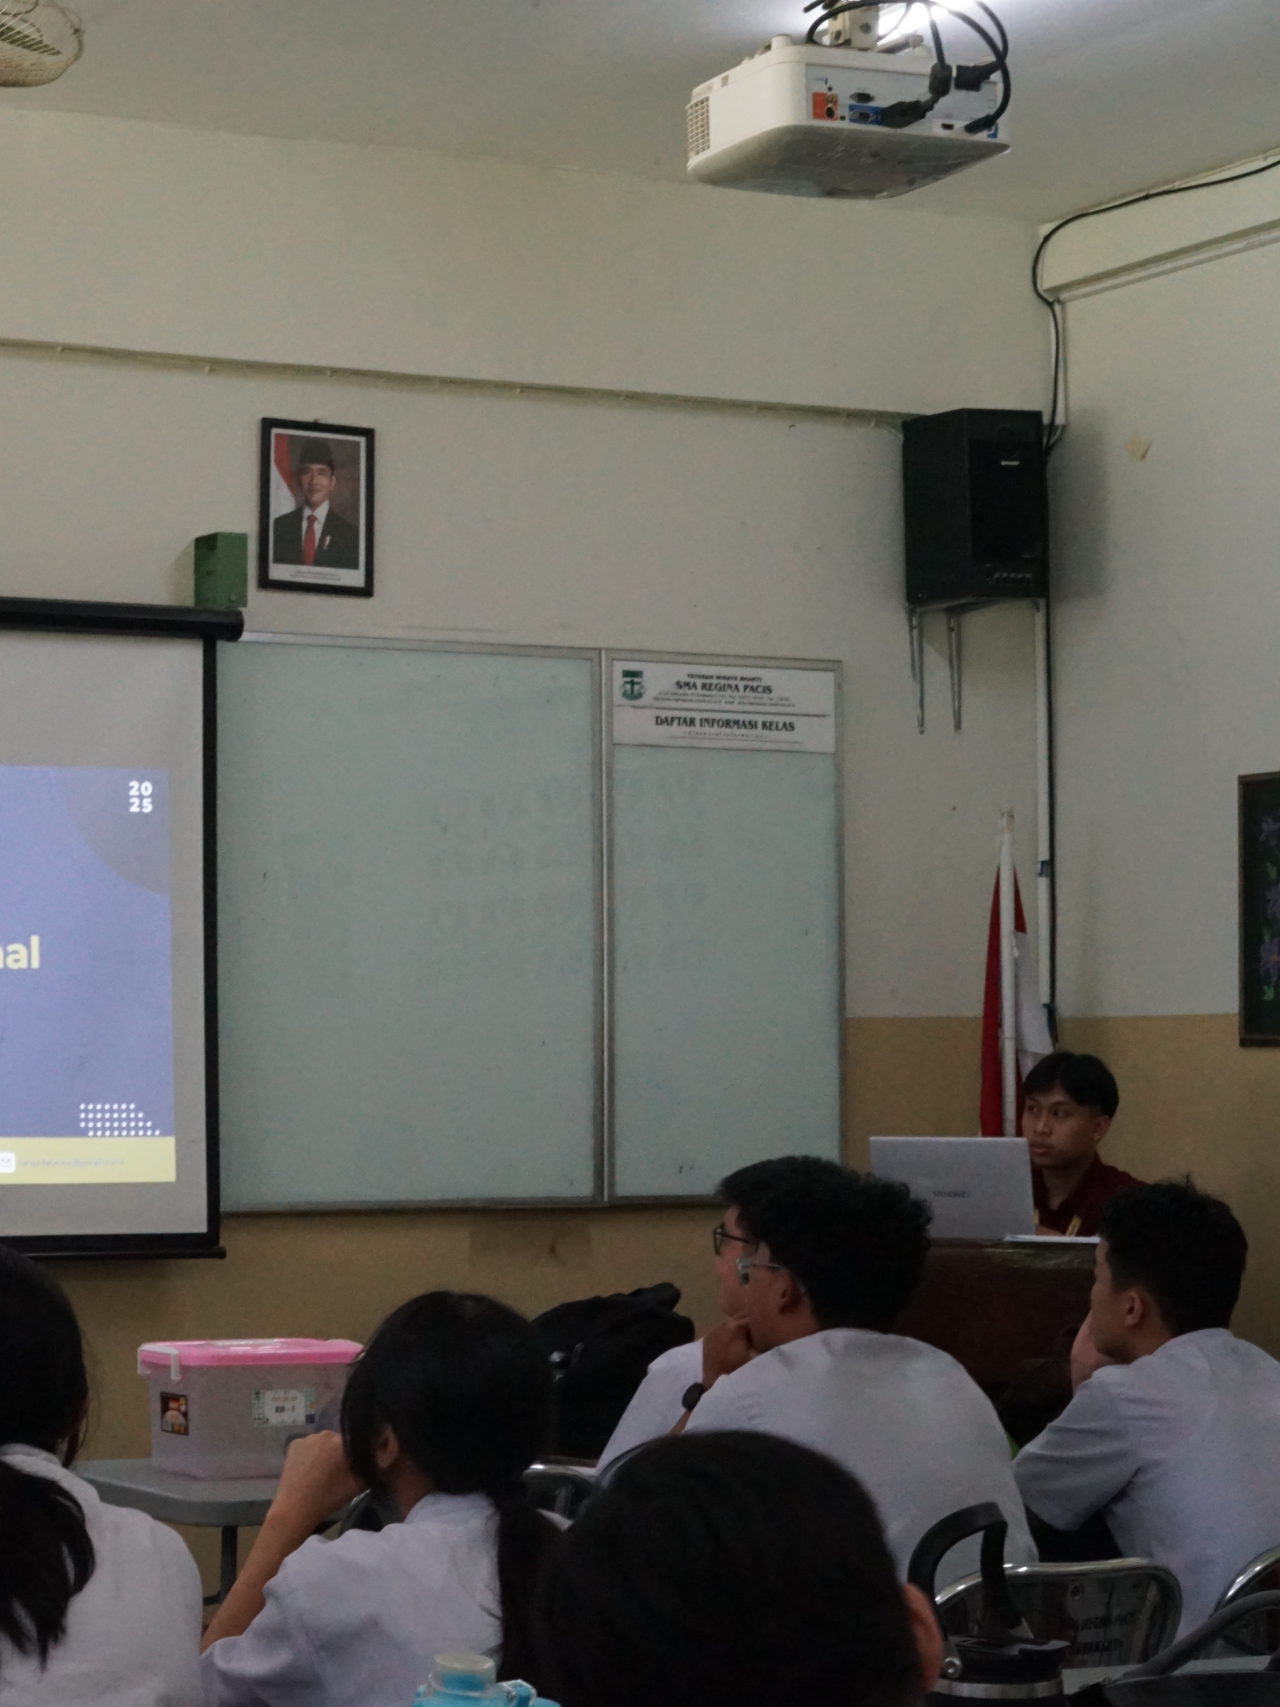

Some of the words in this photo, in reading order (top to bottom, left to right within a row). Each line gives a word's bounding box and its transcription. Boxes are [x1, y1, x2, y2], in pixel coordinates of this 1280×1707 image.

[675, 680, 697, 690] SMA
[701, 682, 740, 693] REGINA
[743, 684, 773, 694] PACIS
[655, 715, 696, 727] DAFTAR
[699, 717, 758, 730] INFORMASI
[761, 720, 795, 732] KELAS
[128, 780, 153, 797] 20
[128, 797, 153, 813] 25
